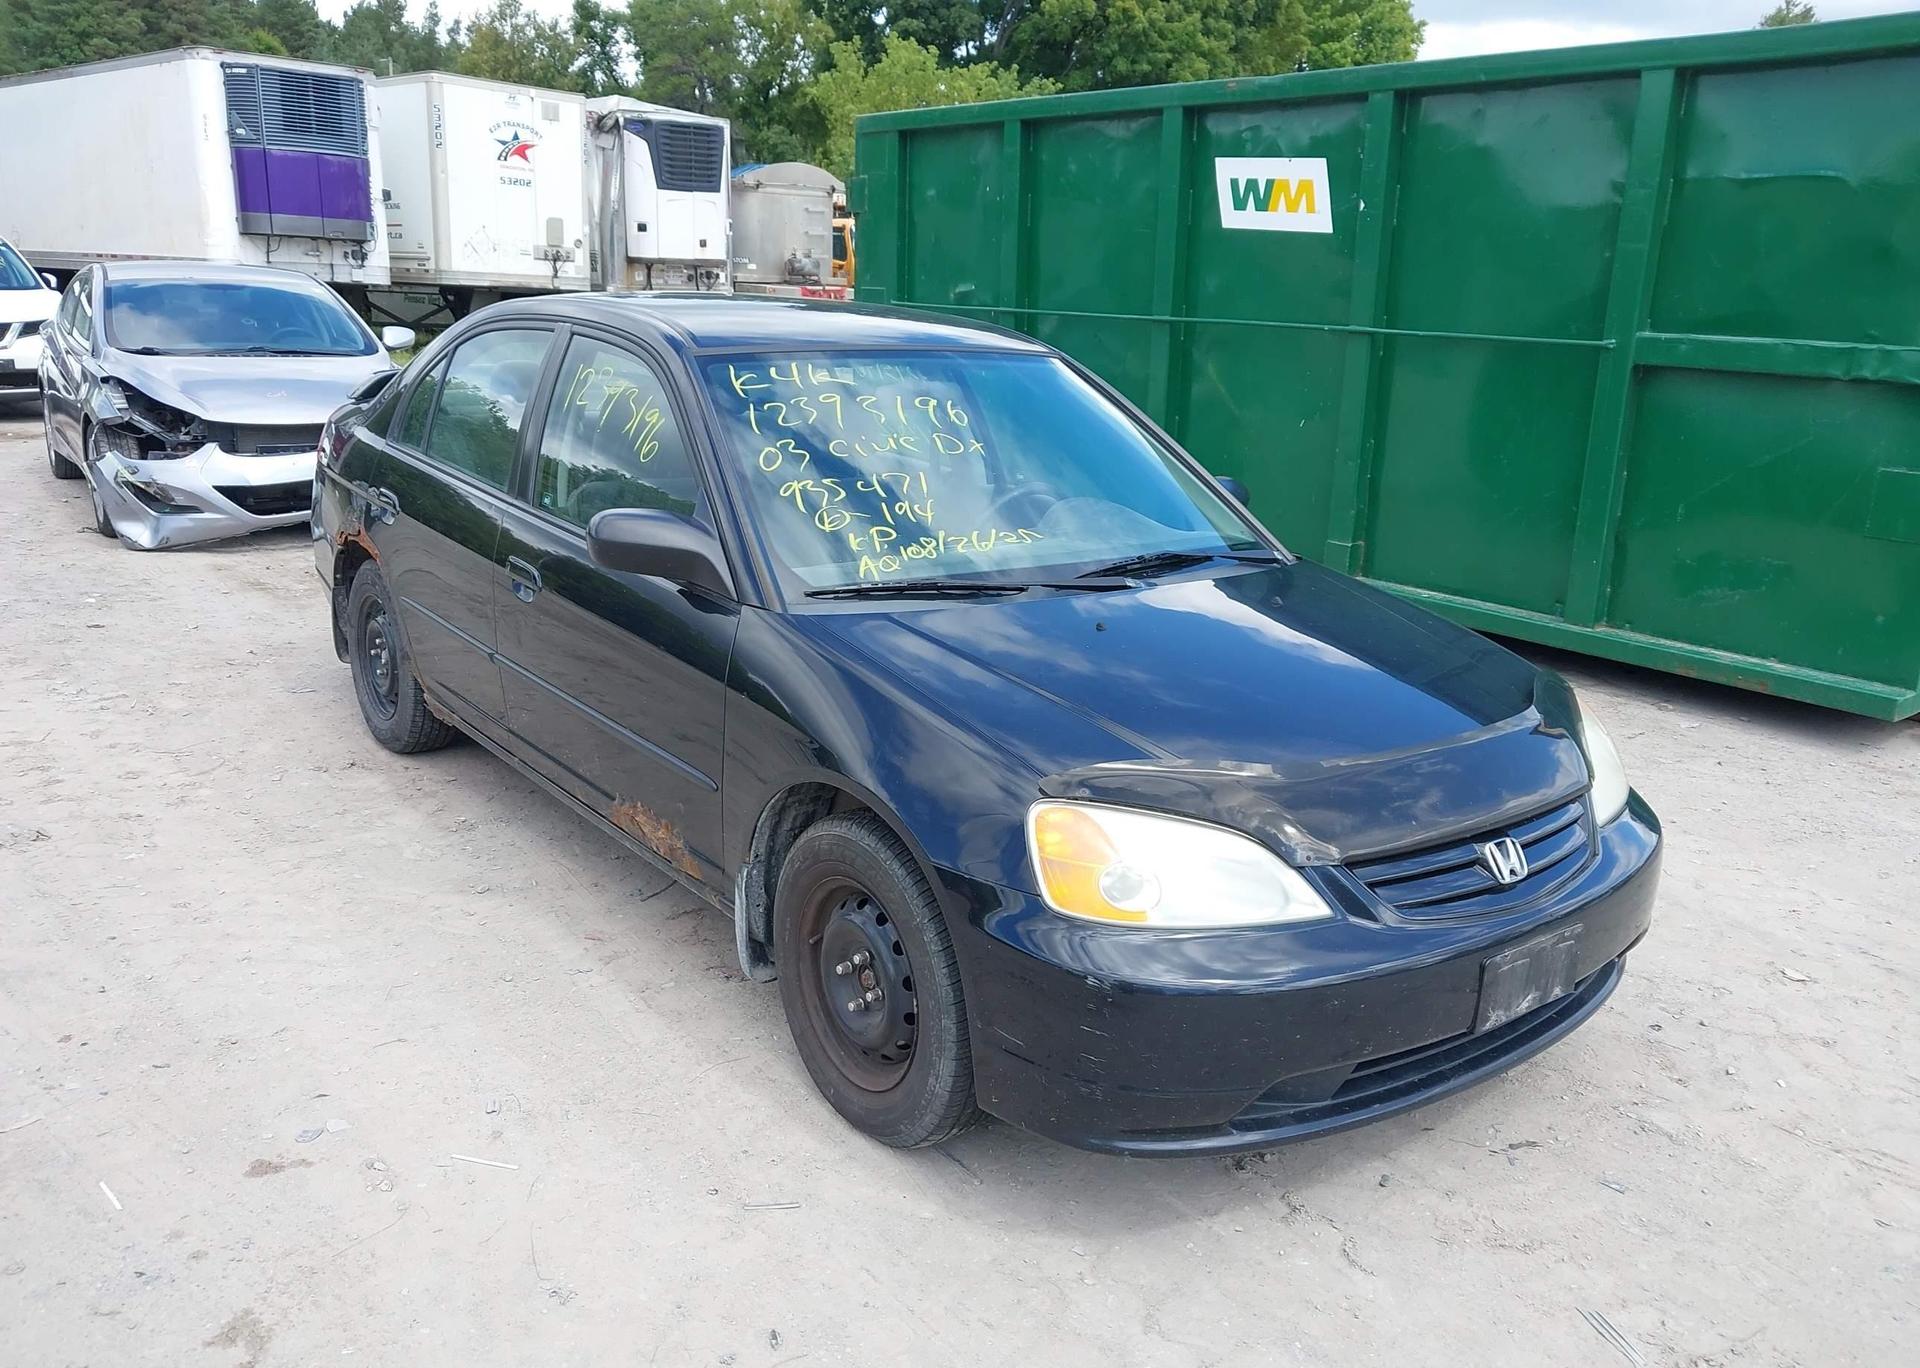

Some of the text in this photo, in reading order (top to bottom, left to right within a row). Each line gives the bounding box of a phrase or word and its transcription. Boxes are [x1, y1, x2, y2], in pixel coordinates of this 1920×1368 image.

[433, 104, 443, 149] 53202
[500, 176, 532, 188] 53202
[1230, 177, 1316, 214] WM
